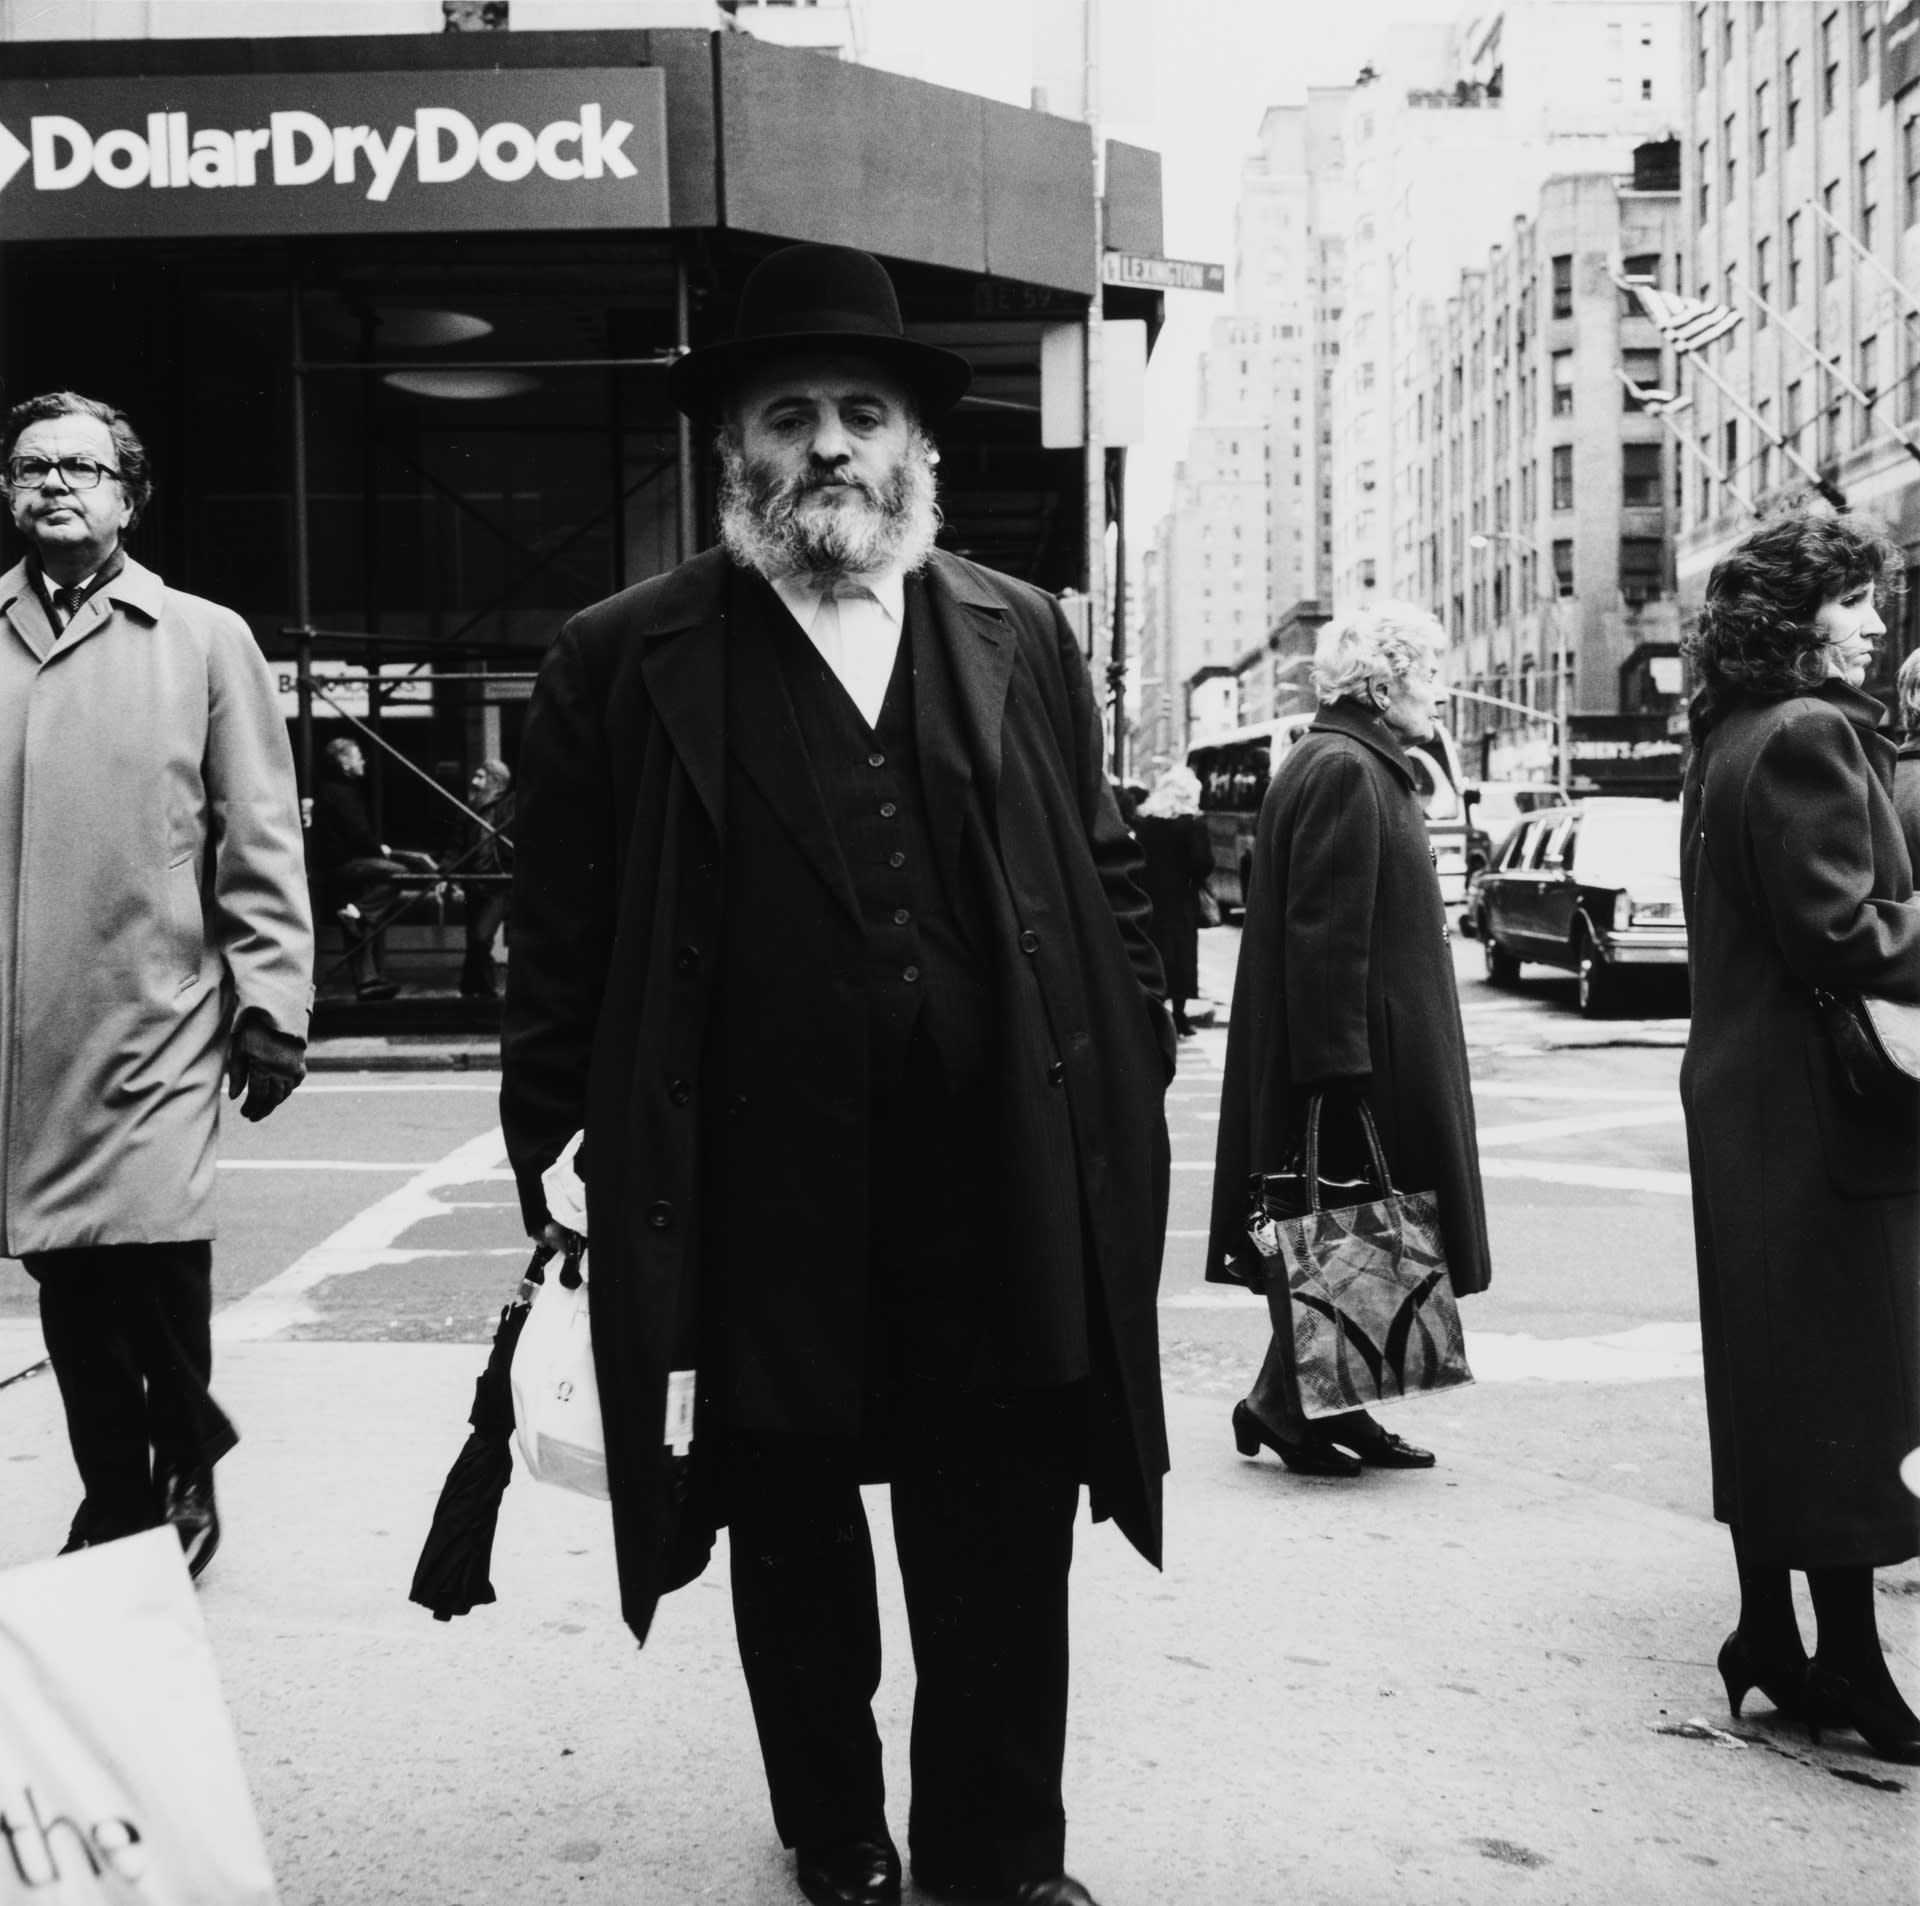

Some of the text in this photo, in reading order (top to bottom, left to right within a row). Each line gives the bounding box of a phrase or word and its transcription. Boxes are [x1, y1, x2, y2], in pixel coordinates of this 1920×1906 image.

[31, 103, 637, 201] DollarDryDock
[1122, 257, 1204, 288] LEXINGTON
[0, 1786, 140, 1888] the
